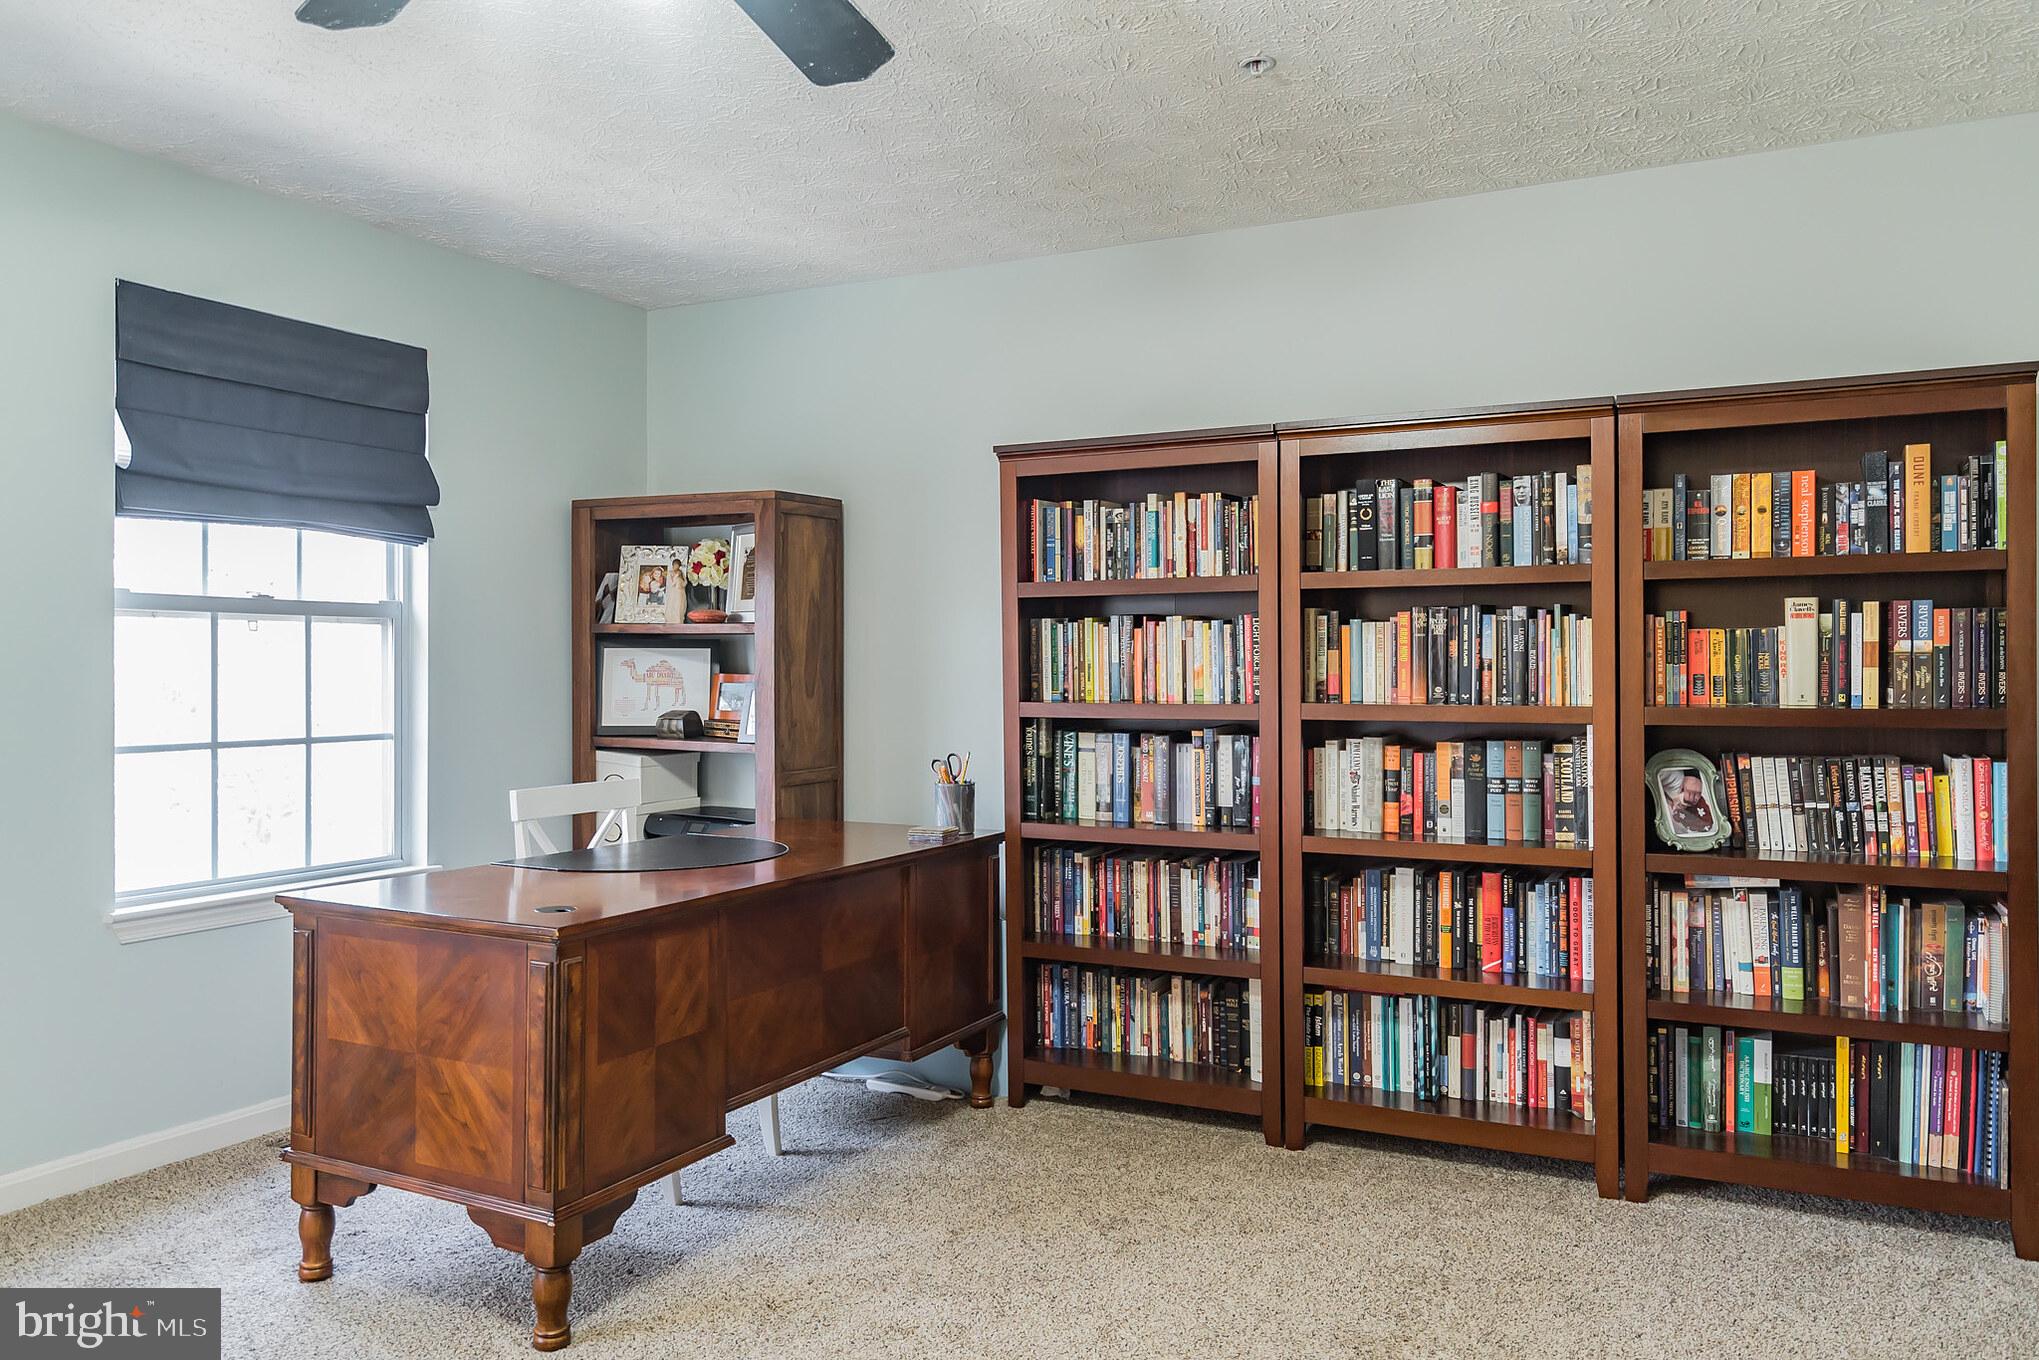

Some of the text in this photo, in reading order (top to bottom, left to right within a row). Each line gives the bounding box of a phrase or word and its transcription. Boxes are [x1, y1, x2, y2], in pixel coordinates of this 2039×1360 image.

[1913, 456, 1925, 487] DUNE
[1798, 476, 1812, 556] neal stephenson
[1898, 605, 1907, 637] RIVERS
[1919, 605, 1928, 637] RIVERS
[1252, 618, 1261, 672] LIGHT FORCE
[1978, 673, 1986, 695] RIVERS
[1998, 672, 2006, 694] RIVERS
[1064, 732, 1075, 768] VINE'S
[1561, 757, 1573, 803] SCOTLAND
[1573, 928, 1578, 937] TO
[1759, 908, 1768, 950] PARENTING
